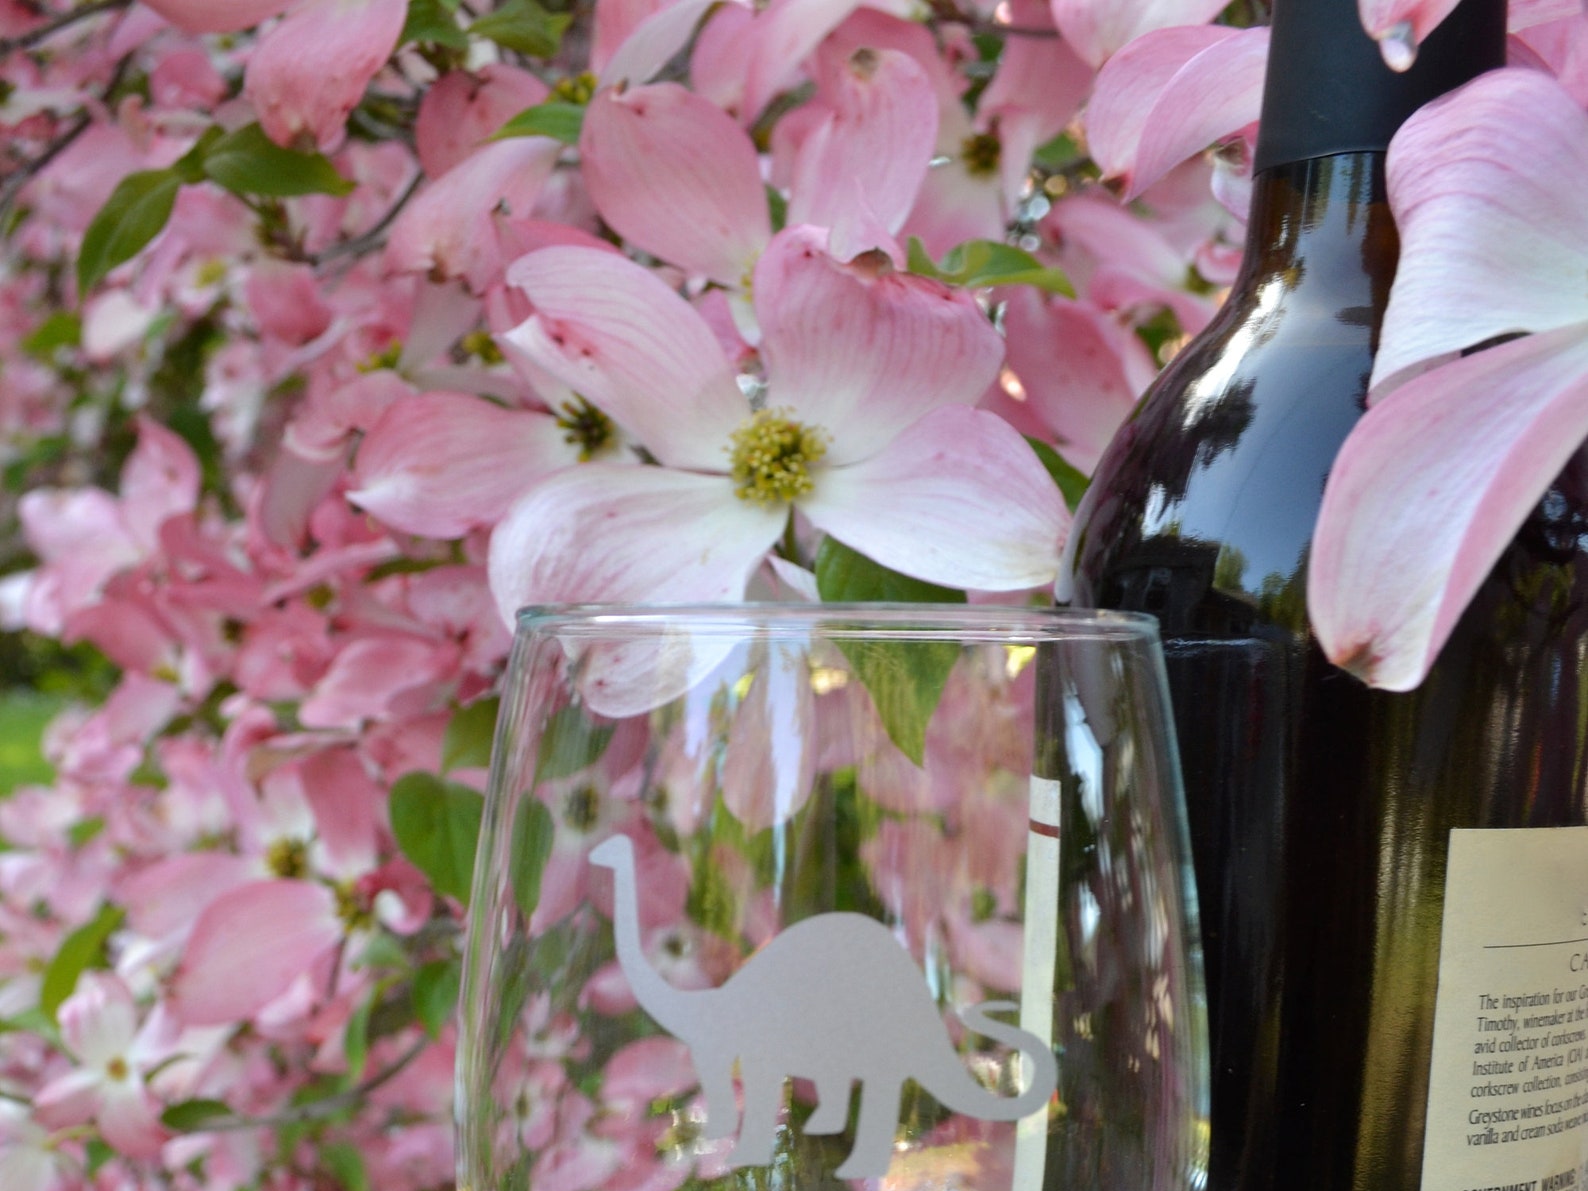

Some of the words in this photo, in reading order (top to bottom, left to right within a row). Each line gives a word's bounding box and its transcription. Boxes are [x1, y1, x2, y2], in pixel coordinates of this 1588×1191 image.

[1479, 994, 1499, 1010] The
[1502, 992, 1550, 1014] inspiration
[1552, 988, 1564, 1004] for
[1477, 1014, 1520, 1036] Timothy,
[1523, 1009, 1566, 1029] winemaker
[1474, 1037, 1496, 1054] avid
[1499, 1036, 1539, 1053] collector
[1540, 1031, 1552, 1048] of
[1472, 1061, 1513, 1076] Institute
[1518, 1056, 1529, 1072] of
[1531, 1053, 1564, 1071] America
[1470, 1081, 1520, 1098] corkscrew
[1468, 1108, 1519, 1129] Greystone
[1520, 1104, 1543, 1119] wines
[1467, 1128, 1498, 1146] vanilla
[1501, 1124, 1519, 1143] and
[1520, 1125, 1546, 1141] cream
